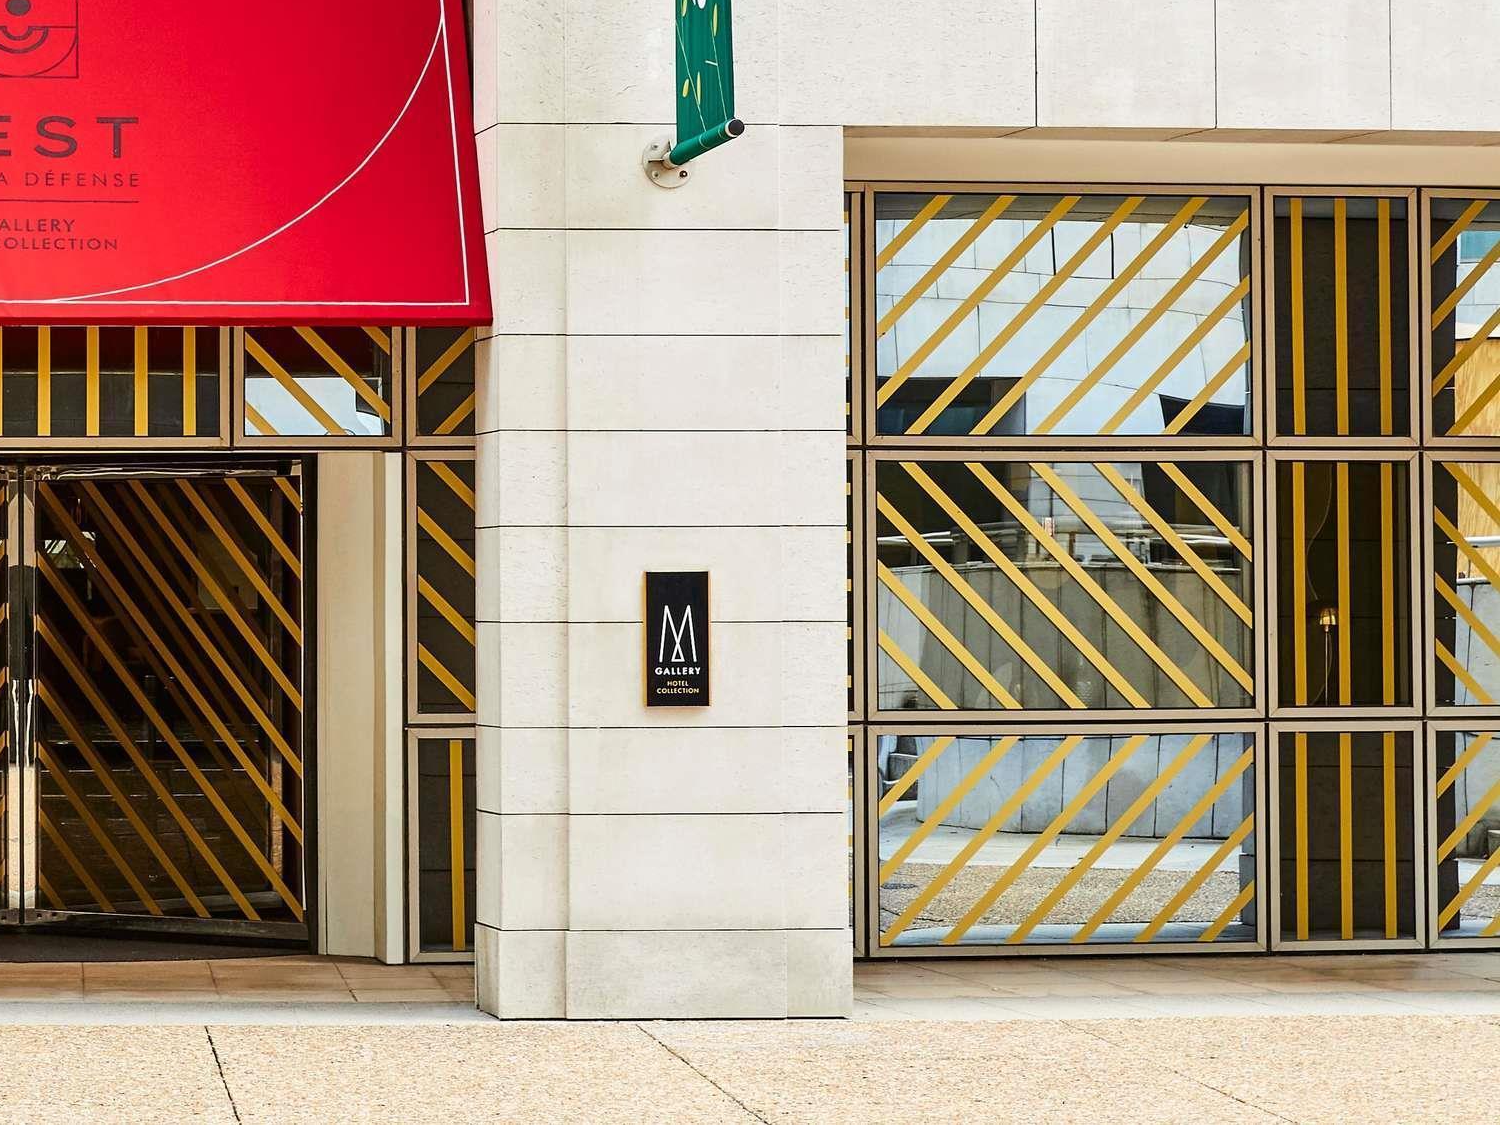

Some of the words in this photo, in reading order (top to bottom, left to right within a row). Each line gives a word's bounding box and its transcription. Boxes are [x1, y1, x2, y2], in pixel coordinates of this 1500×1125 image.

[25, 170, 140, 188] DÉFENSE
[659, 604, 697, 663] M
[654, 666, 701, 676] GALLERY
